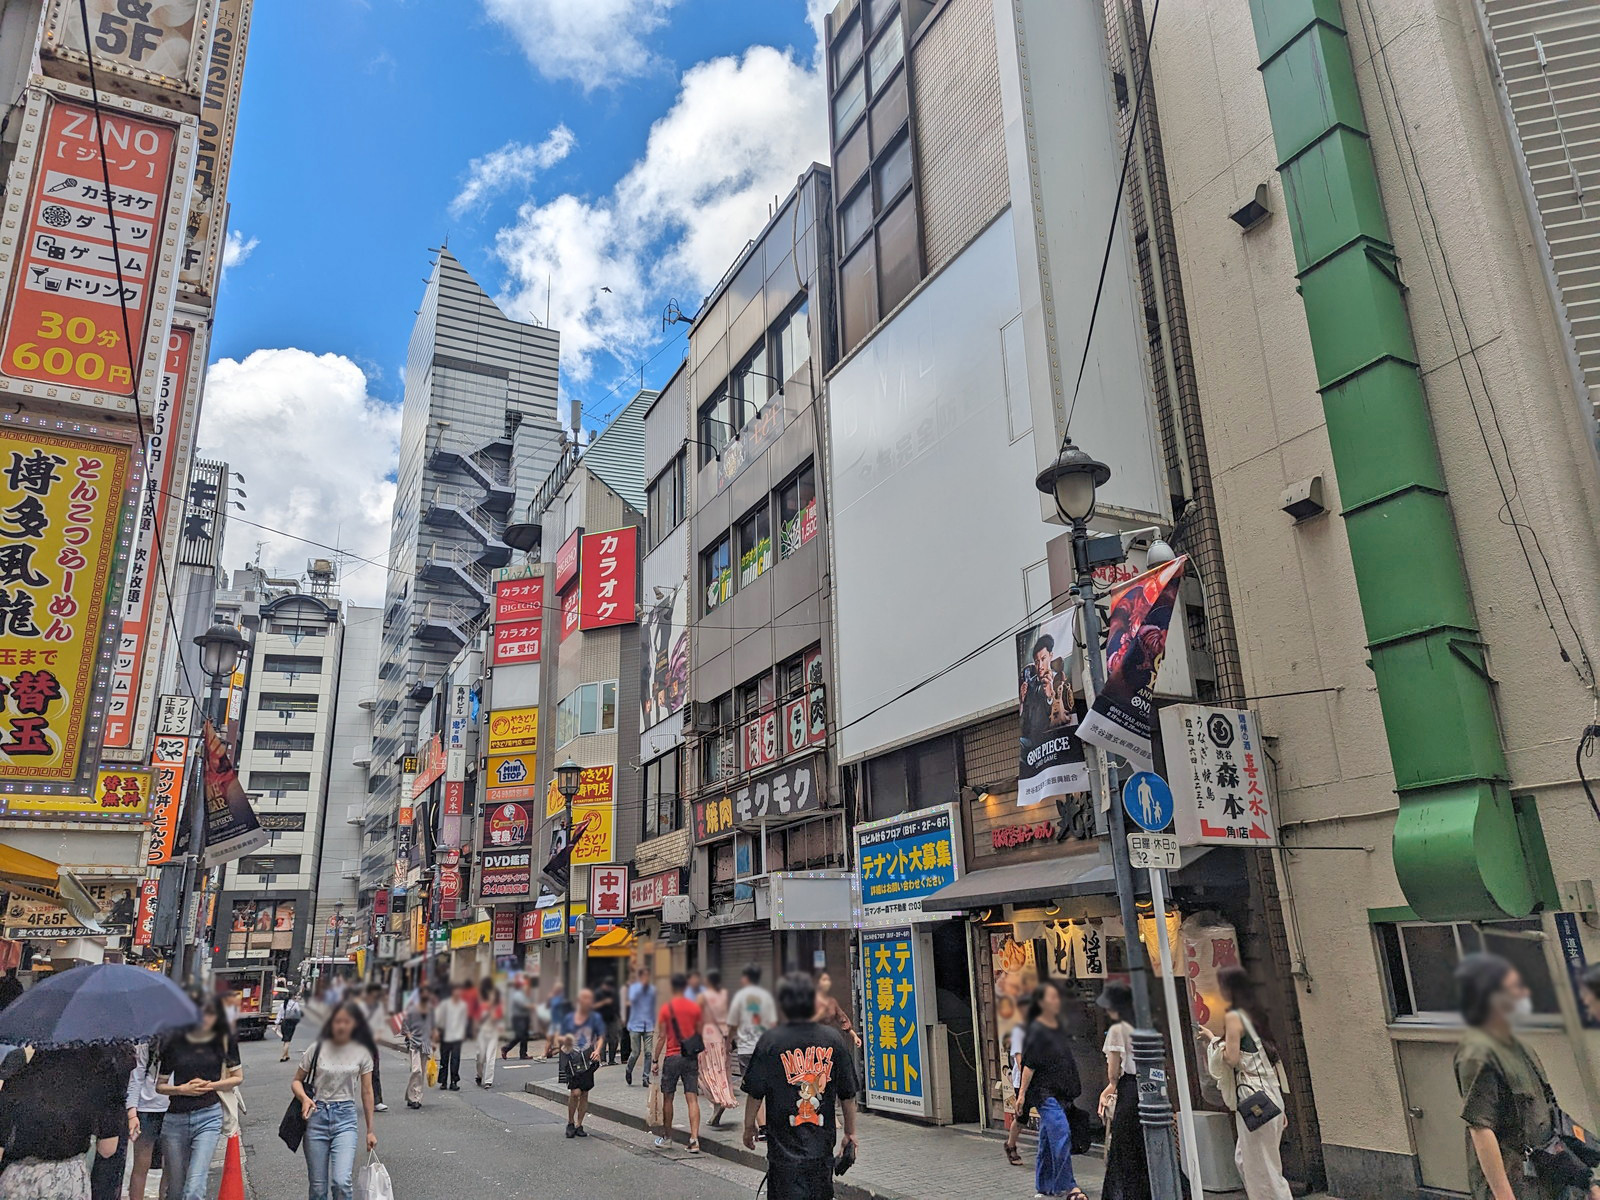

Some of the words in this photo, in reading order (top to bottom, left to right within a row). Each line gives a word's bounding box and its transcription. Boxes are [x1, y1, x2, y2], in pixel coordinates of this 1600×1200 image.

[95, 14, 164, 62] 5F
[203, 28, 232, 110] SHISHA
[61, 110, 160, 156] ZINO
[81, 185, 154, 211] カラオケ
[75, 214, 149, 241] ダーツ
[69, 245, 143, 273] ゲーム
[65, 276, 139, 301] ドリンク
[37, 311, 121, 349] 30分
[12, 343, 134, 386] 600円
[44, 457, 103, 641] とんこつらーめん
[501, 585, 541, 598] カラオケ
[597, 536, 619, 621] カラオケ
[500, 604, 517, 614] BIG
[517, 600, 541, 611] ECHO
[499, 627, 539, 639] カラオケ
[500, 646, 515, 655] 4F
[517, 643, 536, 654] 受付
[161, 697, 176, 733] 正実ビル
[793, 708, 802, 746] モク
[766, 720, 774, 756] モク
[1041, 736, 1070, 757] PIECE
[1215, 750, 1233, 760] 渋谷
[502, 772, 522, 781] STOP
[503, 765, 521, 773] MINI
[1243, 753, 1268, 817] 喜久水
[449, 783, 458, 810] バラの木
[706, 796, 733, 834] 焼肉
[736, 768, 811, 821] モクモク
[1214, 762, 1245, 820] 森本
[575, 846, 608, 858] センター
[862, 839, 952, 880] テナント大募集
[27, 913, 67, 925] 4F&5F
[874, 943, 898, 1091] 大募集!!
[894, 942, 918, 1092] テナント
